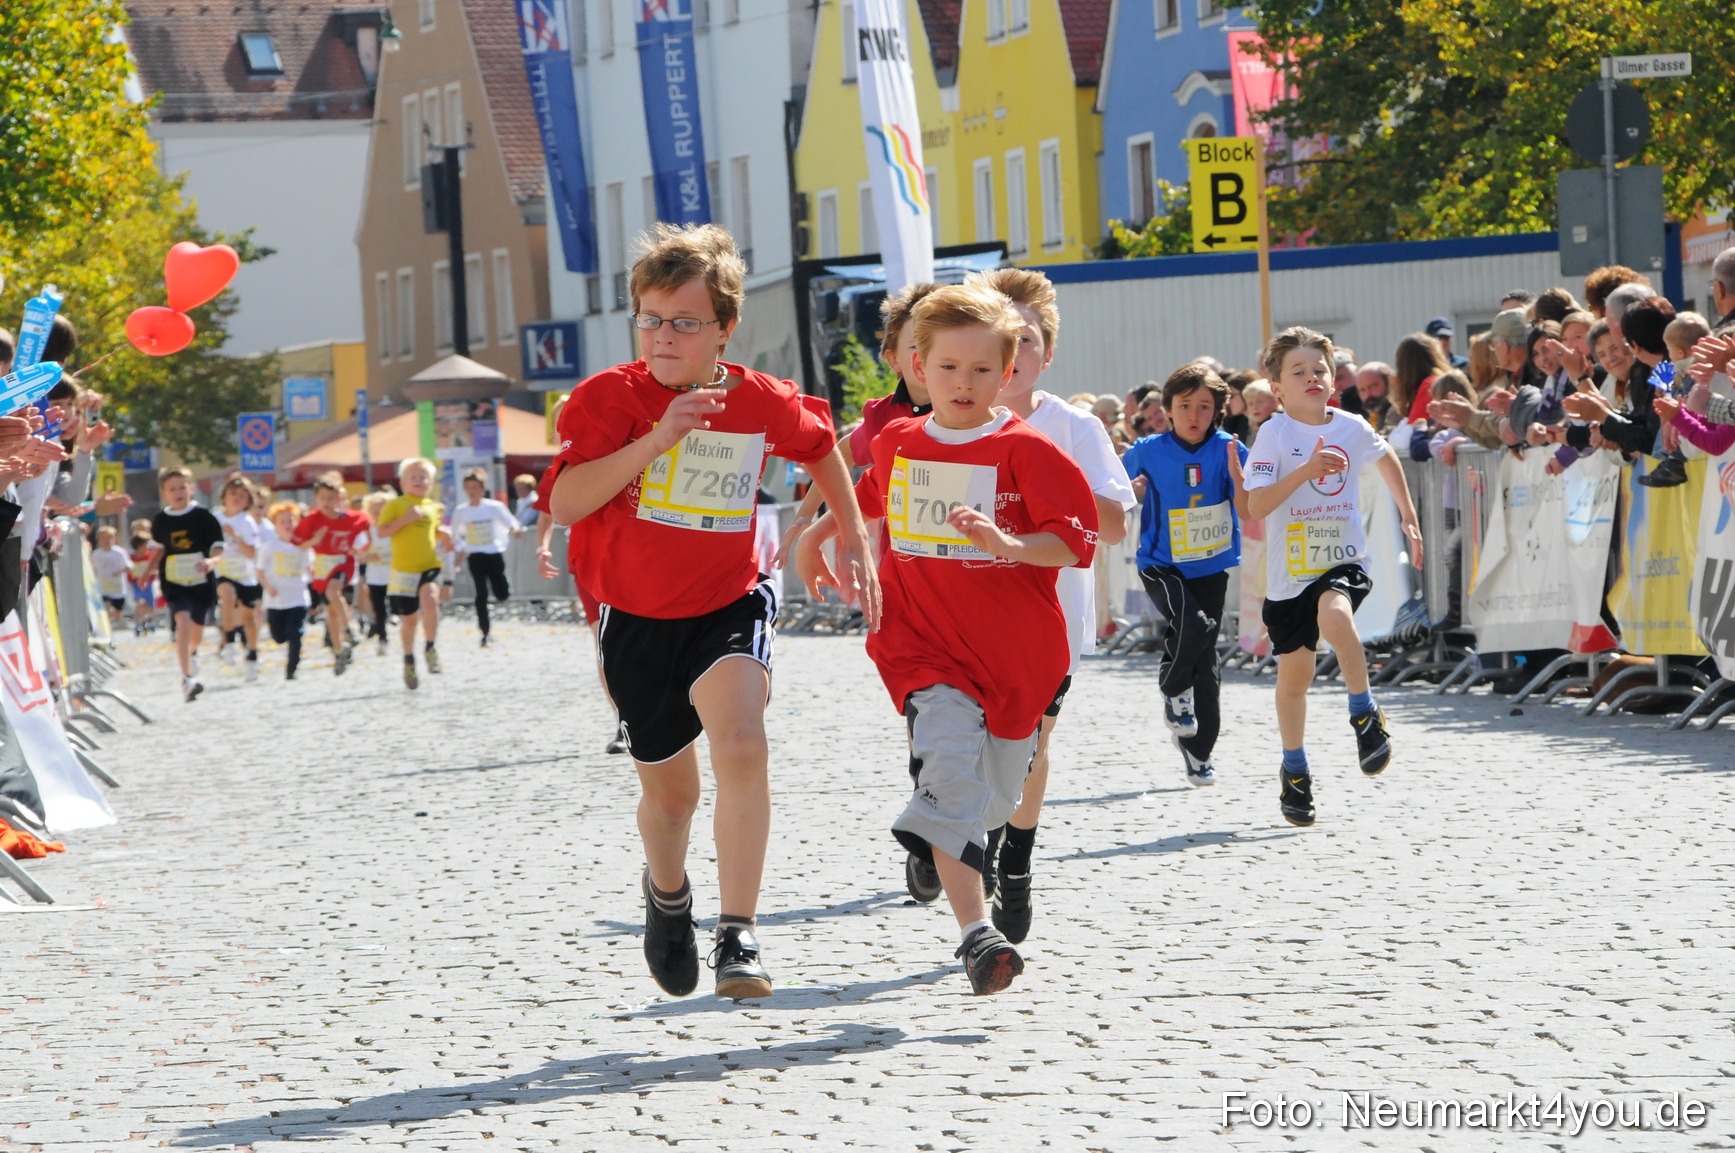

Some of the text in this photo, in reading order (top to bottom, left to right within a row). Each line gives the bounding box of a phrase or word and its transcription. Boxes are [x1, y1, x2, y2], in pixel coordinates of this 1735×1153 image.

[1618, 59, 1685, 73] Ulmer Gasse
[664, 33, 693, 157] RUPPERT
[1198, 142, 1255, 162] Block
[679, 165, 700, 212] K&L
[1211, 172, 1247, 226] B
[685, 436, 734, 460] Maxim
[243, 453, 275, 469] TAXI
[651, 460, 666, 475] K4
[683, 467, 752, 499] 7268
[912, 467, 930, 486] Uli
[891, 492, 902, 507] K4
[996, 493, 1021, 501] KTER
[1326, 504, 1341, 512] MIT
[715, 516, 750, 526] PFLEIDERER
[1188, 510, 1212, 522] David
[1190, 521, 1229, 543] 7006
[1308, 526, 1341, 538] Patrick
[1290, 545, 1300, 555] K4
